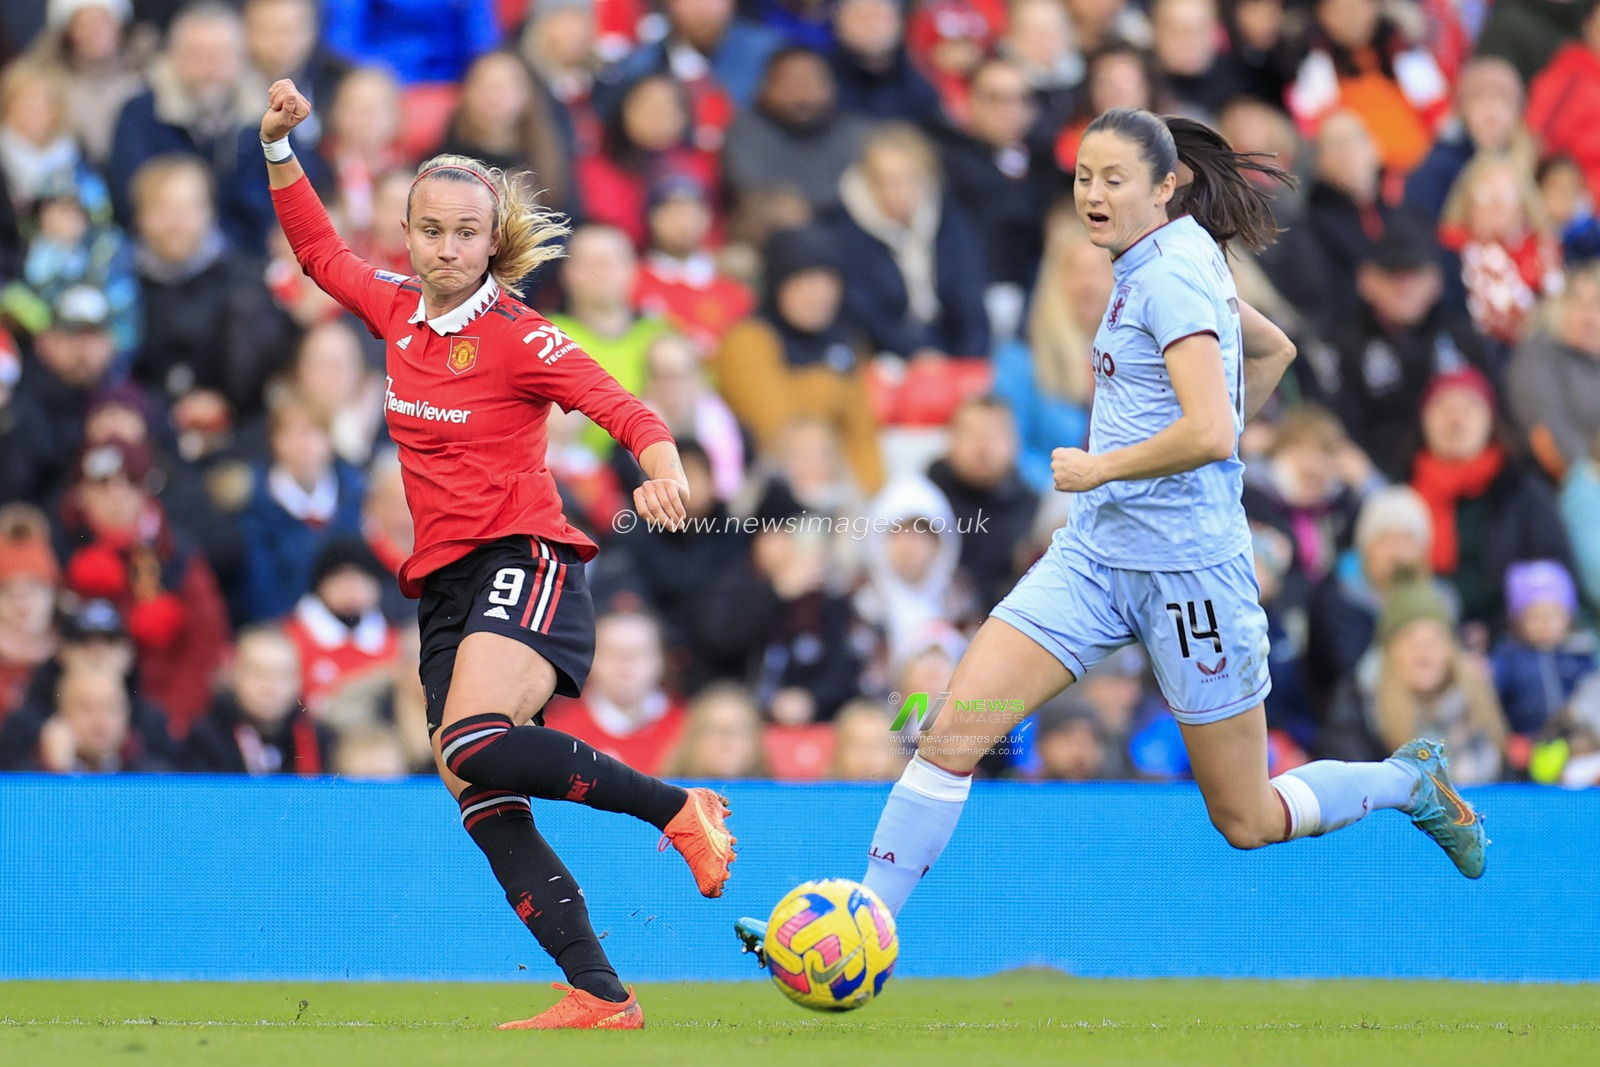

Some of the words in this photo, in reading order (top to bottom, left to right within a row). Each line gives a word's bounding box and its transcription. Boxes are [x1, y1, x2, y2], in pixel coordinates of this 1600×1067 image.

[388, 391, 472, 424] TeamViewer
[488, 567, 526, 606] 9
[1165, 599, 1224, 659] 14
